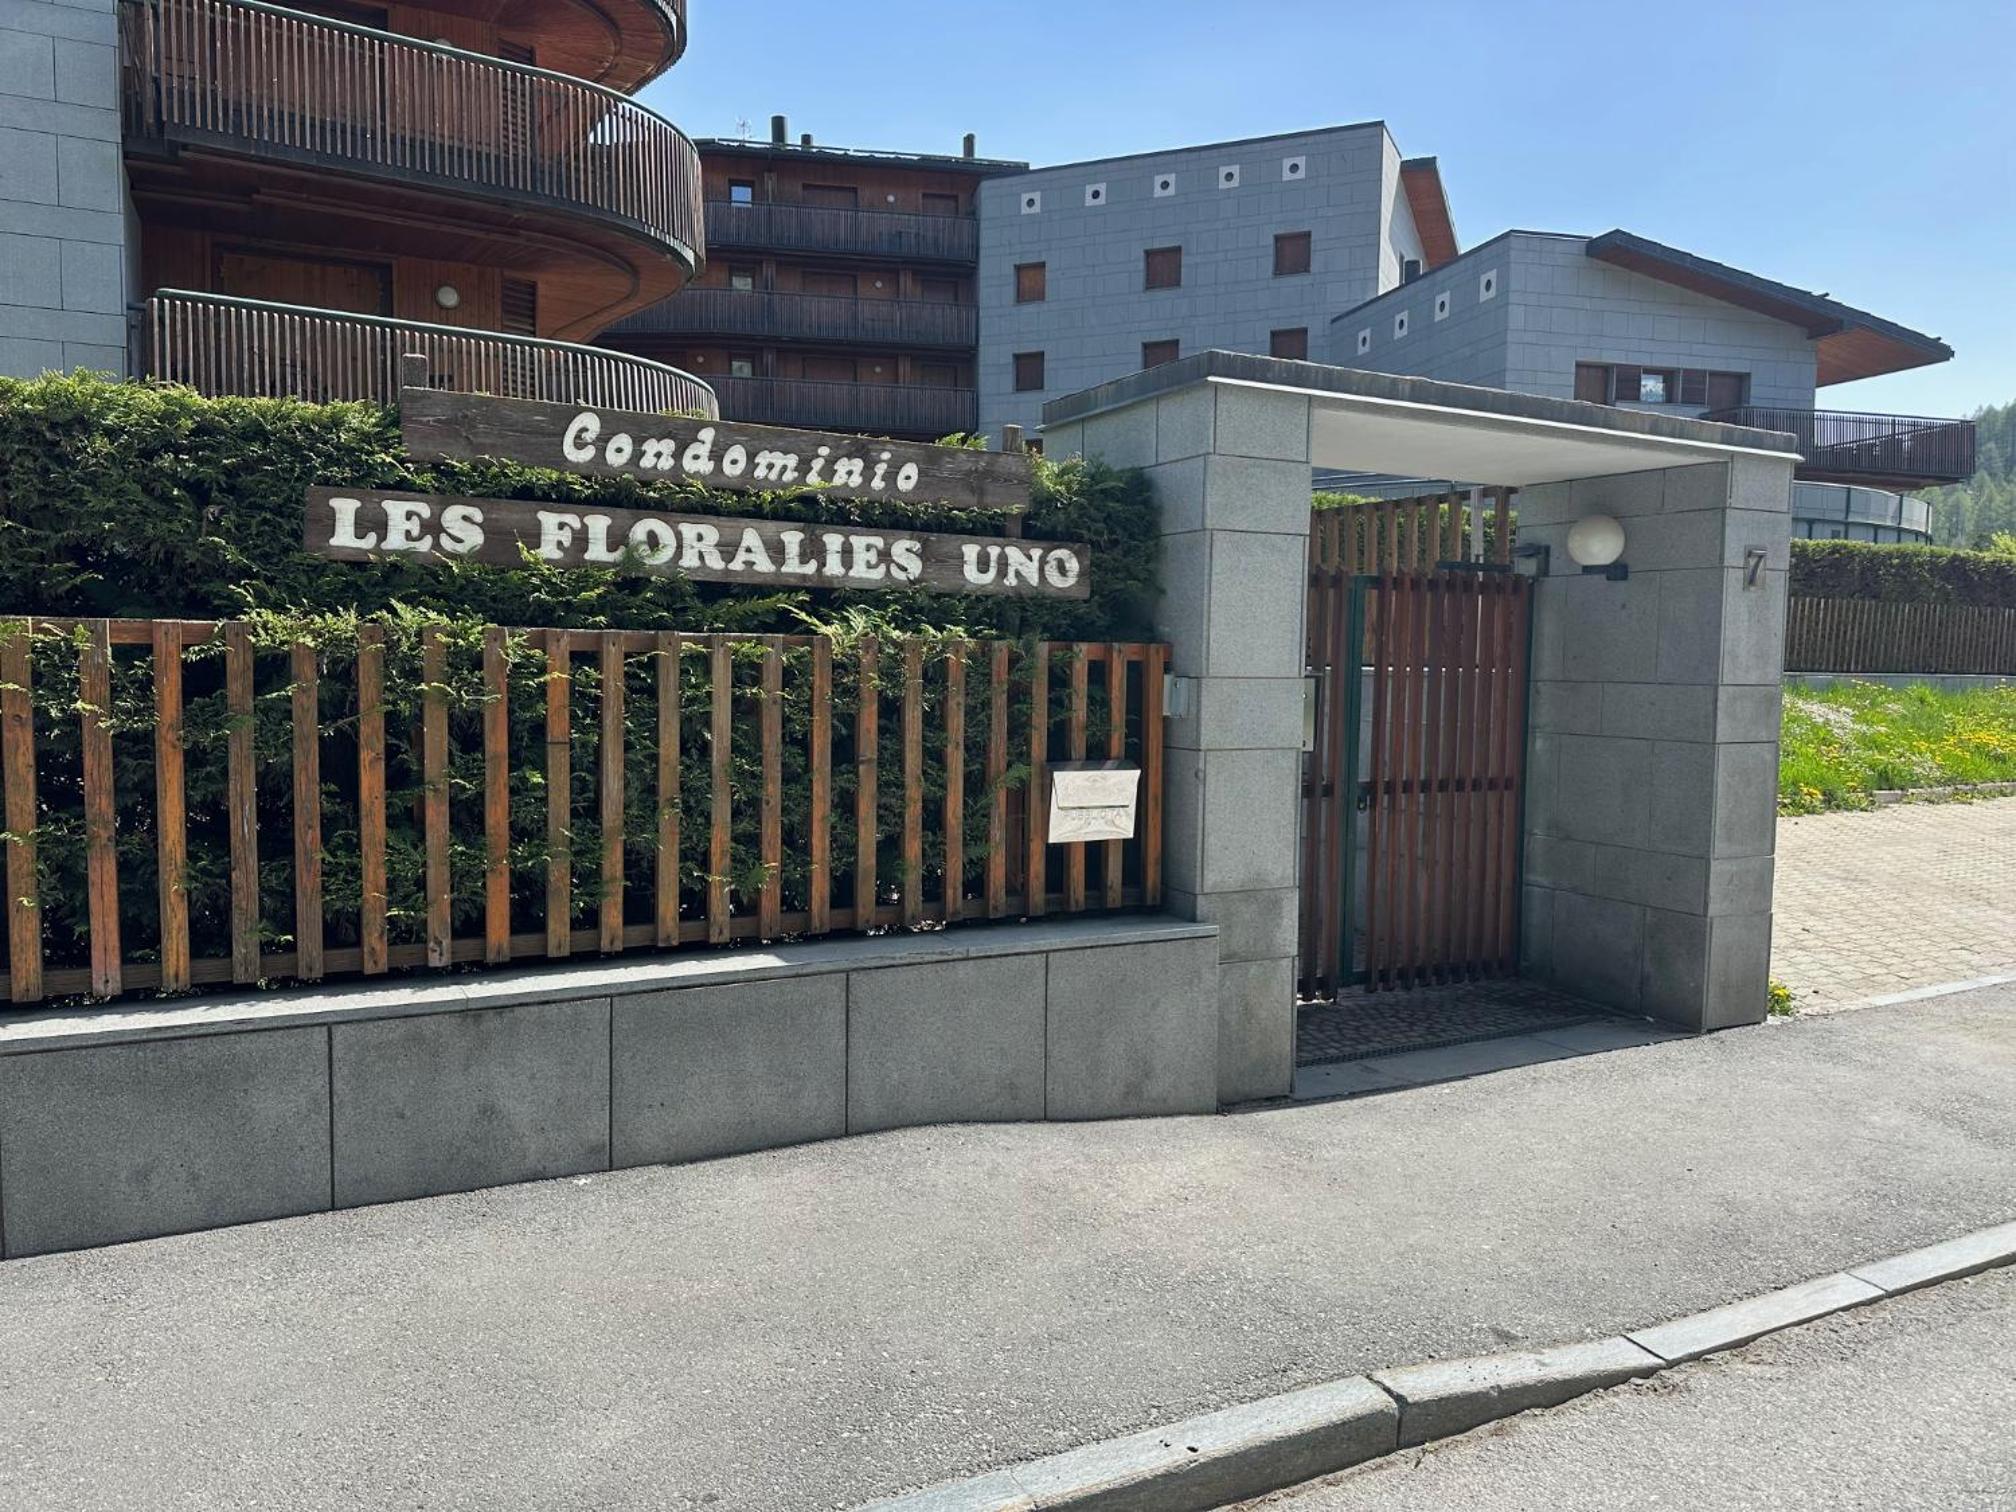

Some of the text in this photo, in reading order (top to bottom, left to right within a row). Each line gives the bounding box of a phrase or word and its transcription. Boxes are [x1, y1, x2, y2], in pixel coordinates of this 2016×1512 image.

[562, 411, 919, 493] Condominio
[328, 497, 1080, 588] LES FLORALIES UNO
[1747, 549, 1768, 586] 7
